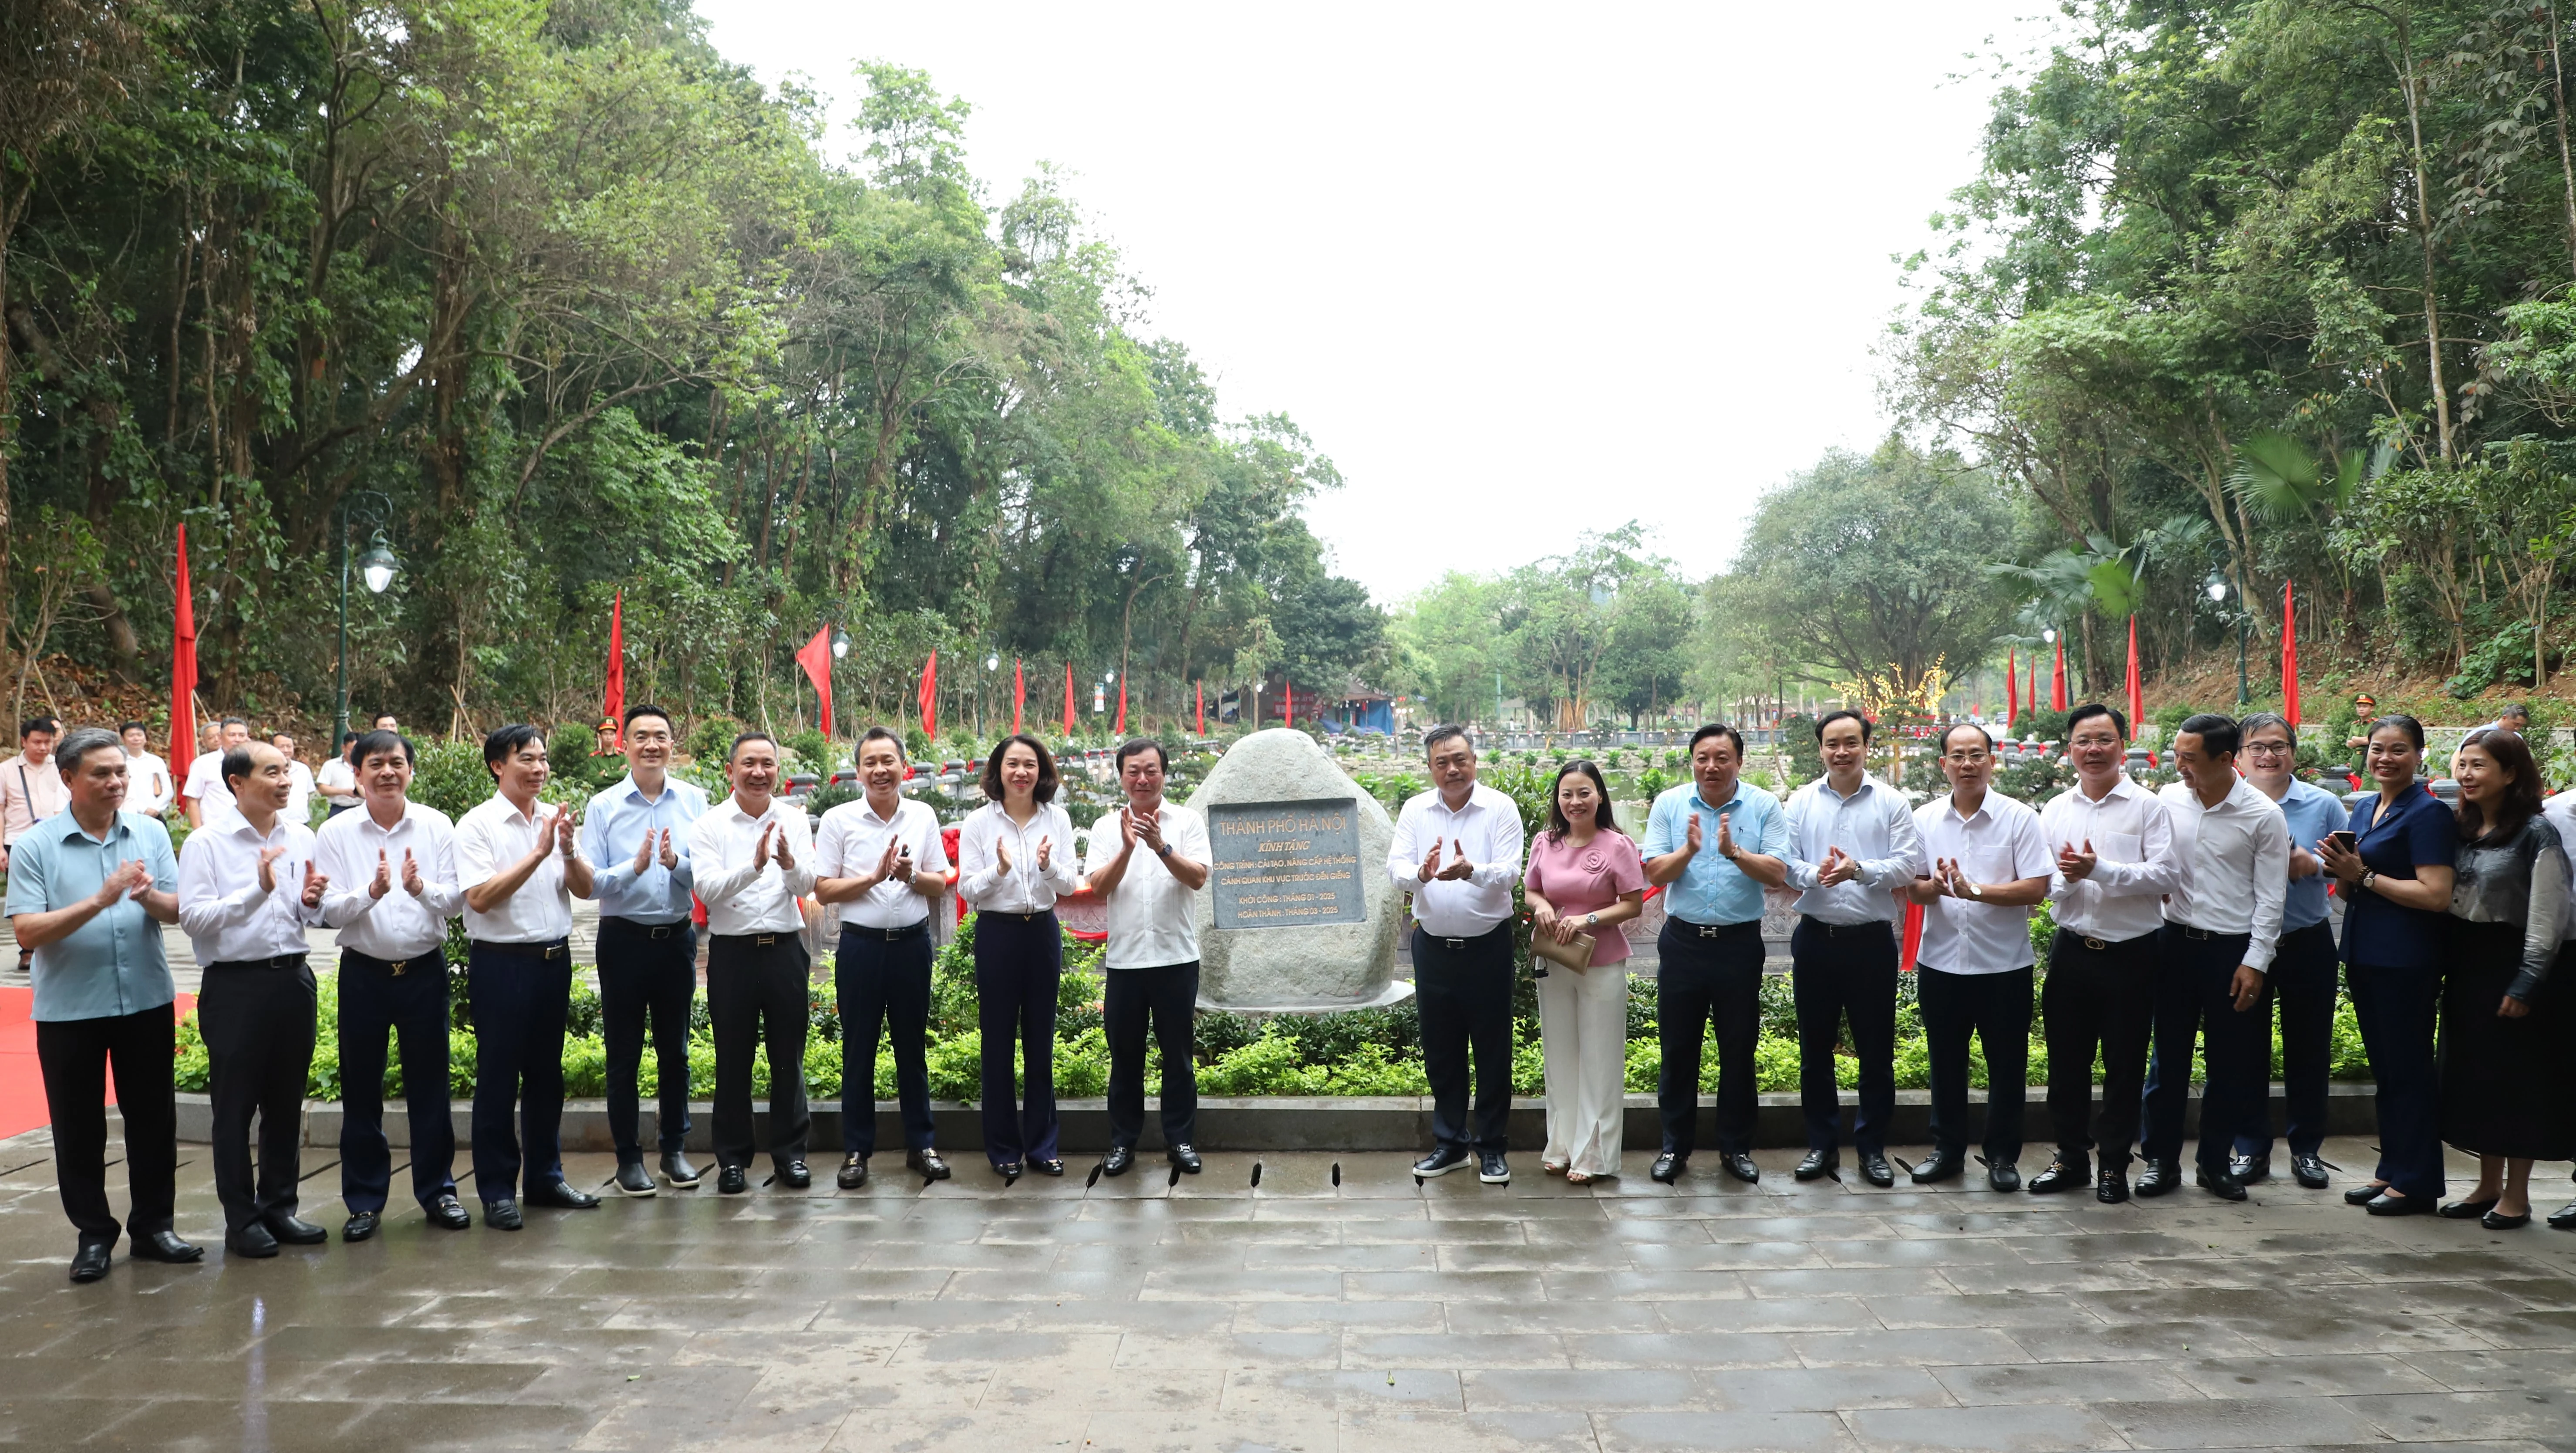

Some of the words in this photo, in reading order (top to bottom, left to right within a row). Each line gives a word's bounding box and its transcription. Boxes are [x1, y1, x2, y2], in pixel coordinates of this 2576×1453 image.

[1220, 817, 1265, 835] THÀNH
[1268, 811, 1295, 833] PHỐ
[1299, 813, 1318, 831] HÀ
[1322, 812, 1345, 835] NỘI
[1258, 840, 1284, 852] KÍNH
[1284, 838, 1310, 853] TẶNG
[1214, 861, 1235, 870] CÔNG
[1257, 858, 1270, 868] CẢI
[1287, 858, 1308, 867] NÂNG
[1308, 855, 1323, 865] CẤP
[1323, 855, 1332, 866] HỆ
[1332, 854, 1356, 864] THỐNG
[1221, 875, 1241, 885] CẢNH
[1291, 872, 1315, 882] TRƯỚC
[1330, 869, 1351, 880] GIẾNG
[1239, 894, 1255, 904] KHỞI
[1256, 894, 1278, 903] CÔNG
[1282, 892, 1306, 902] THÁNG
[1238, 909, 1258, 919] HOÀN
[1258, 908, 1281, 917] THÀNH
[1285, 906, 1309, 916] THÁNG
